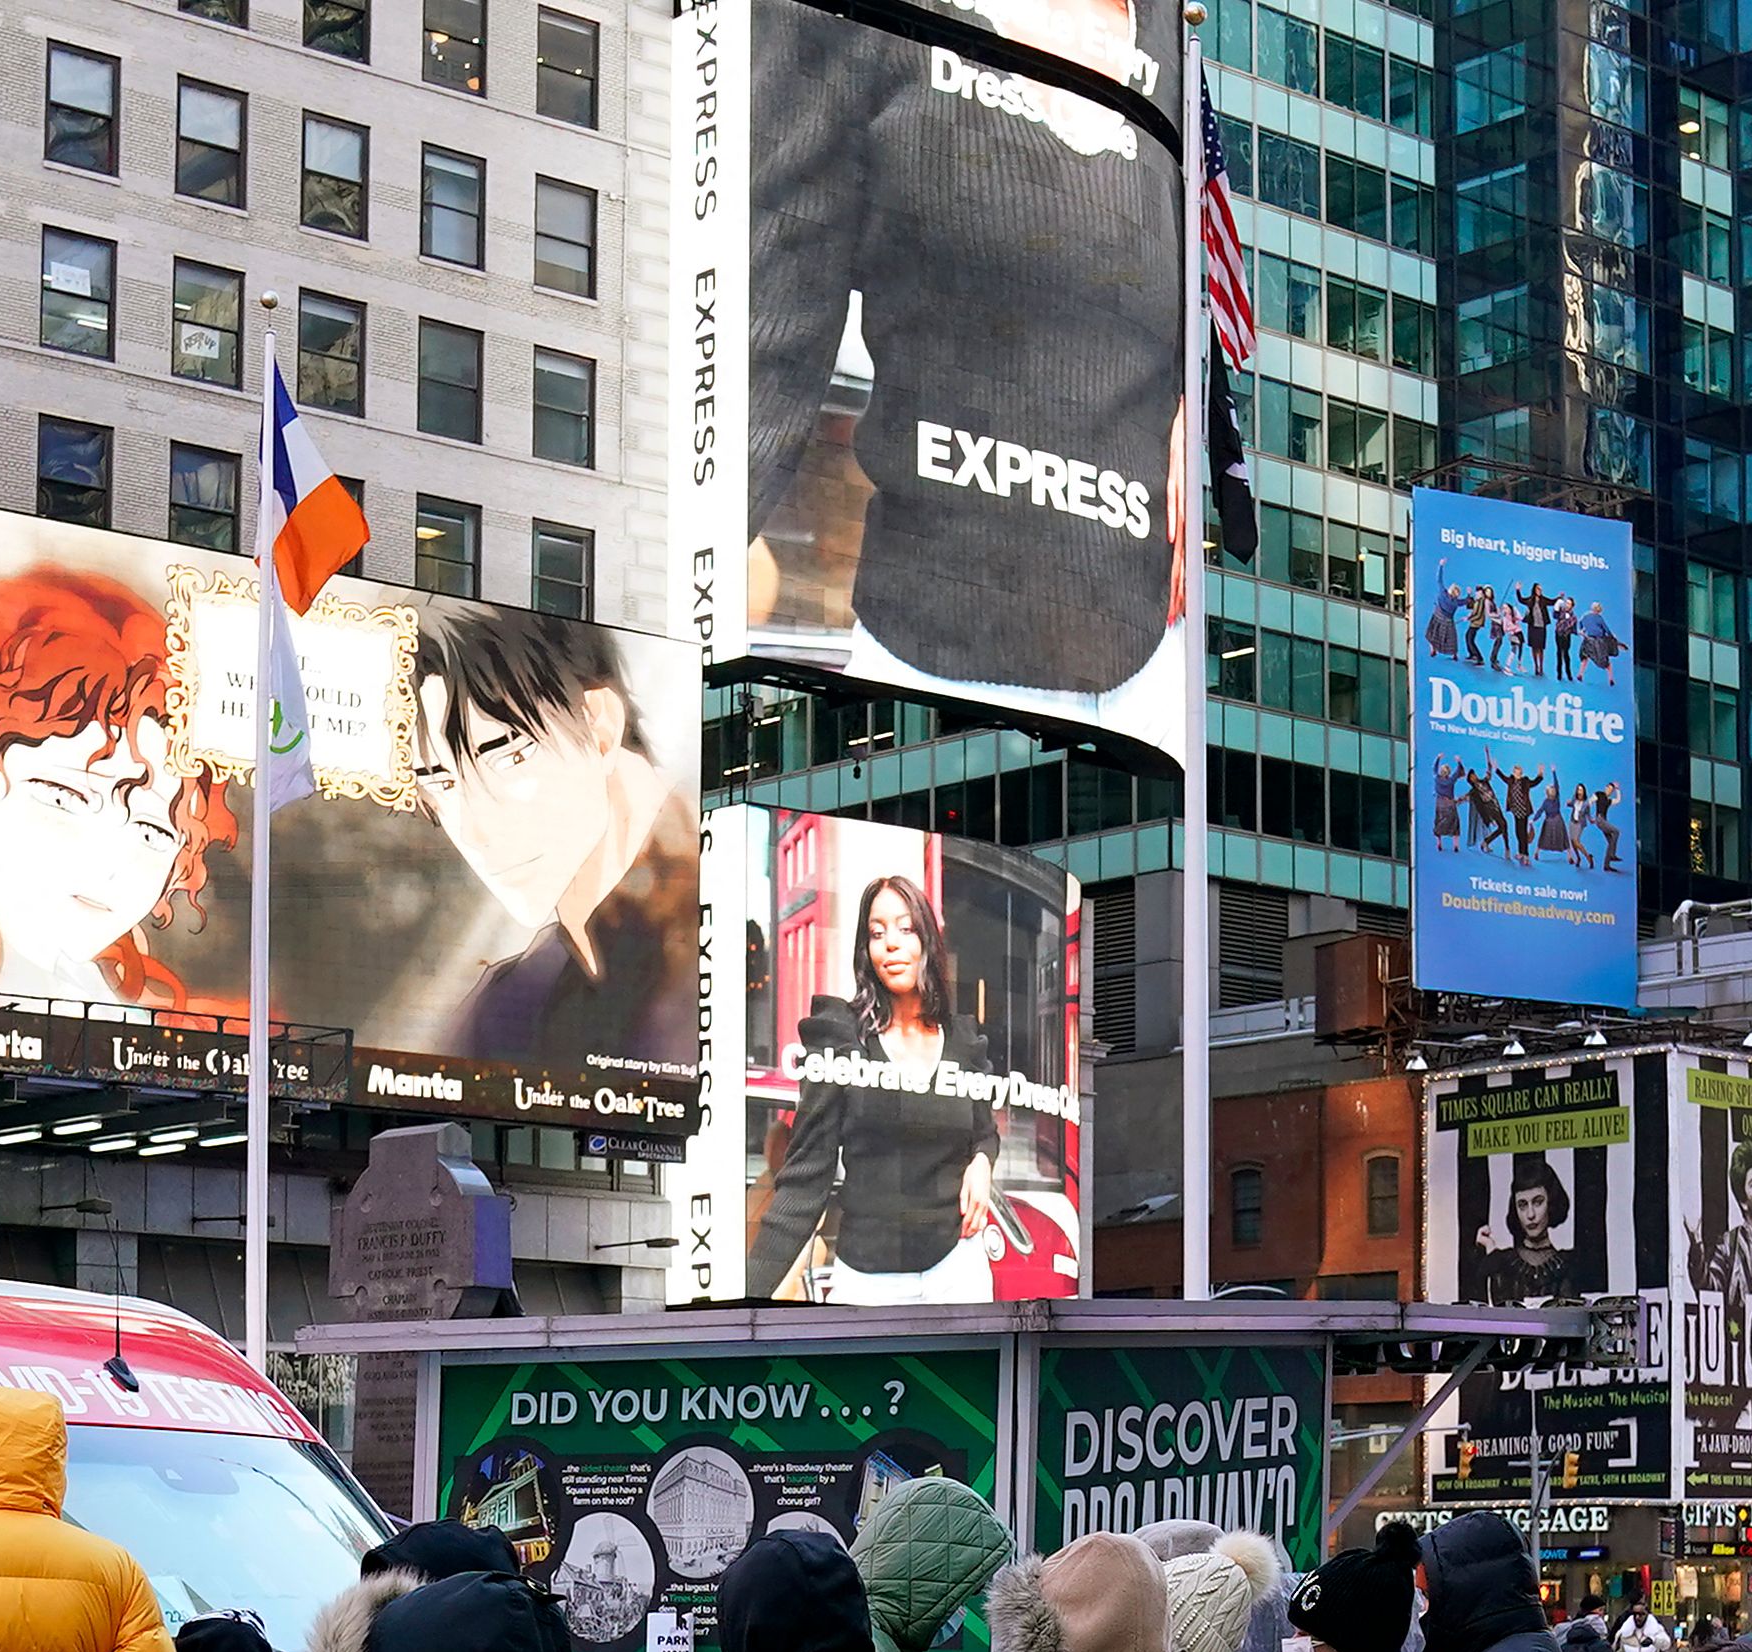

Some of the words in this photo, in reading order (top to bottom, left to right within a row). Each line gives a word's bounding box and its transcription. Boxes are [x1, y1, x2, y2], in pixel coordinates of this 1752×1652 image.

[693, 267, 717, 487] EXPRESS
[917, 420, 1151, 540] EXPRESS
[1441, 528, 1465, 548] Big
[1468, 532, 1510, 556] heart,
[1513, 540, 1557, 562] bigger
[1560, 548, 1610, 571] laughs.
[1429, 676, 1625, 743] Doubtfire
[1430, 721, 1446, 733] The
[1448, 724, 1466, 737] New
[1469, 876, 1513, 894] Tickets
[1516, 884, 1531, 896] on
[1534, 885, 1557, 899] sale
[1560, 889, 1588, 902] now!
[1441, 892, 1616, 926] DoubtfireBroadway.com
[176, 1055, 202, 1073] the
[367, 1063, 464, 1102] Manta
[585, 1052, 623, 1071] Original
[623, 1057, 648, 1075] story
[648, 1061, 661, 1076] by
[661, 1061, 680, 1076] Kim
[780, 1042, 932, 1096] Celebrate
[934, 1060, 1009, 1110] Every
[514, 1077, 566, 1111] Under
[569, 1093, 592, 1111] the
[593, 1087, 642, 1116] Oak
[643, 1095, 687, 1123] Tree
[1439, 1097, 1478, 1122] TIMES
[1481, 1092, 1530, 1119] SQUARE
[1534, 1084, 1559, 1110] CAN
[1564, 1076, 1613, 1105] REALLY
[1694, 1077, 1733, 1103] RAISING
[1473, 1126, 1510, 1150] MAKE
[1514, 1122, 1540, 1146] YOU
[1545, 1118, 1578, 1142] FEEL
[1582, 1113, 1625, 1139] ALIVE!
[410, 1230, 448, 1248] DUFFY
[149, 1374, 307, 1440] TESTING
[511, 1391, 577, 1426] DID
[589, 1388, 668, 1423] YOU
[680, 1383, 810, 1421] KNOW
[1543, 1395, 1560, 1410] The
[1608, 1391, 1631, 1406] The
[1064, 1395, 1297, 1477] DISCOVER
[625, 1474, 648, 1484] Times
[786, 1462, 824, 1474] Broadway
[1682, 1502, 1736, 1528] GIFTS
